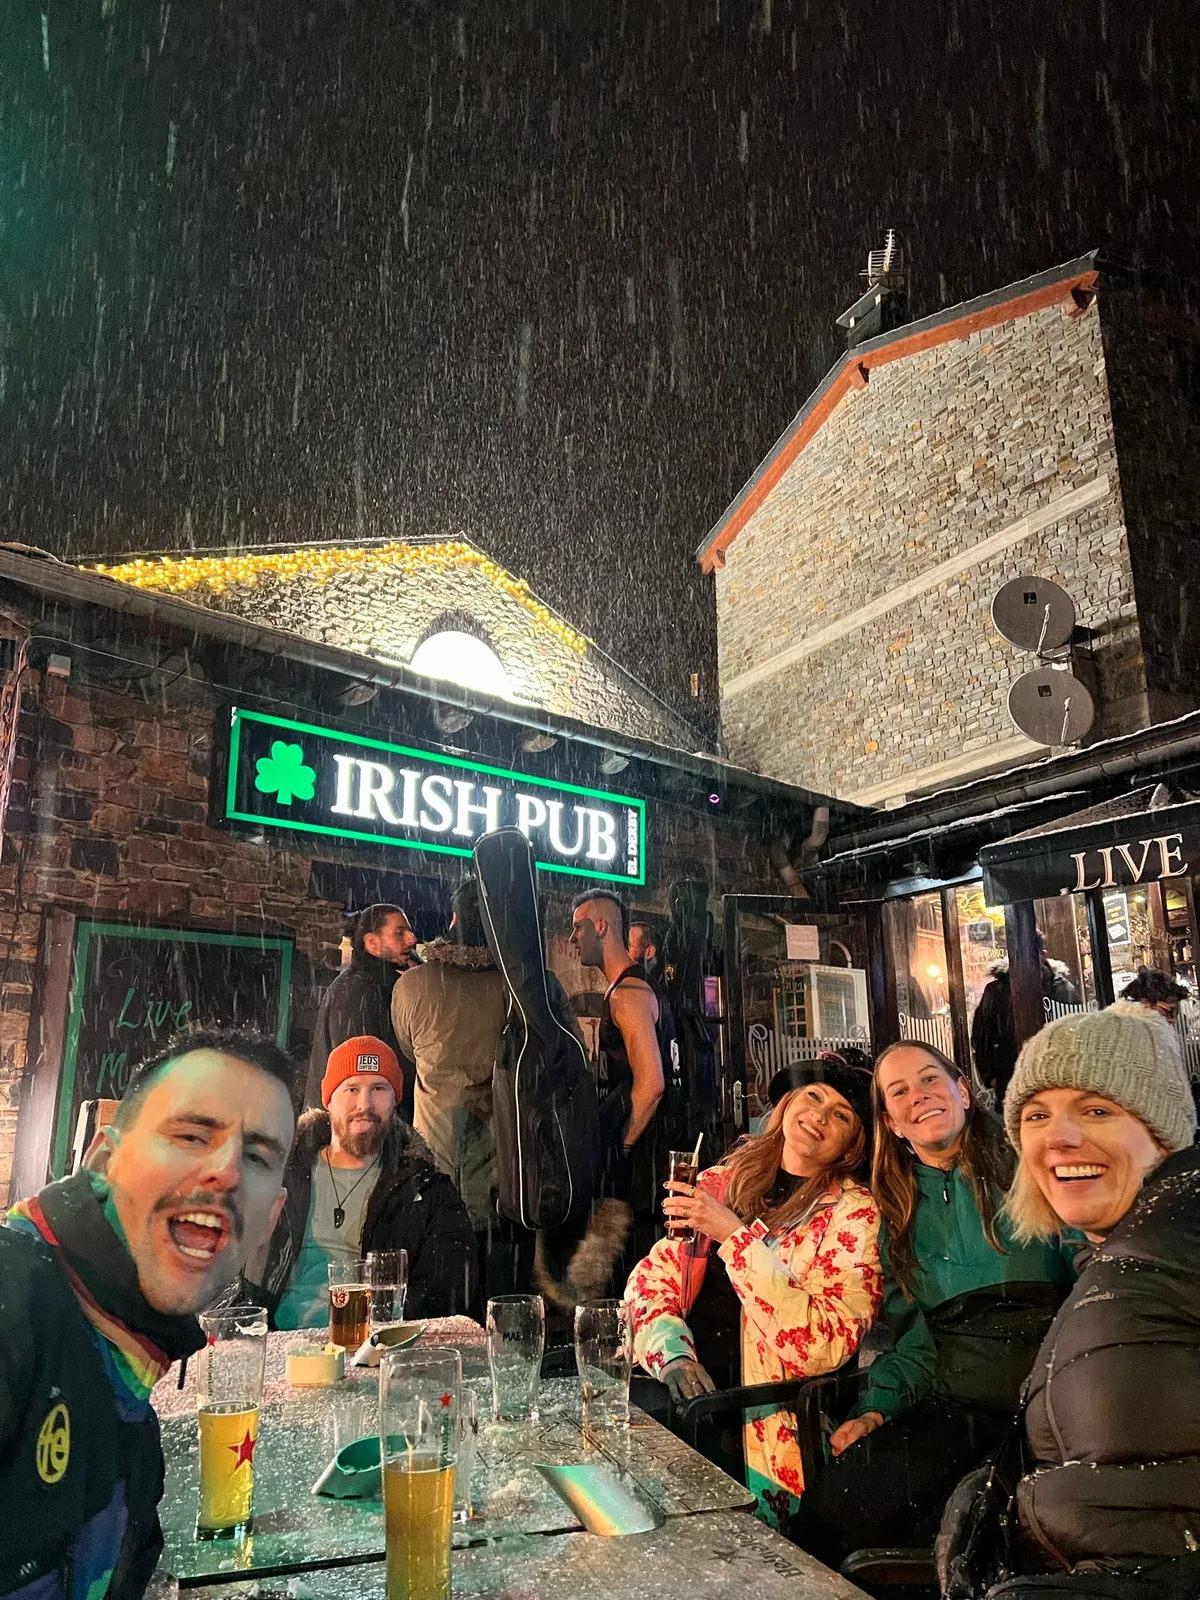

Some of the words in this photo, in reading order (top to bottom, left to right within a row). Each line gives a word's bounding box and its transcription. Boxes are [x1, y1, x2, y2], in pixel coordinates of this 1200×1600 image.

[330, 753, 503, 837] IRISH
[515, 792, 617, 861] PUB
[627, 807, 638, 856] DERBY
[627, 856, 638, 876] EL
[1070, 833, 1189, 892] LIVE
[116, 987, 193, 1031] Live
